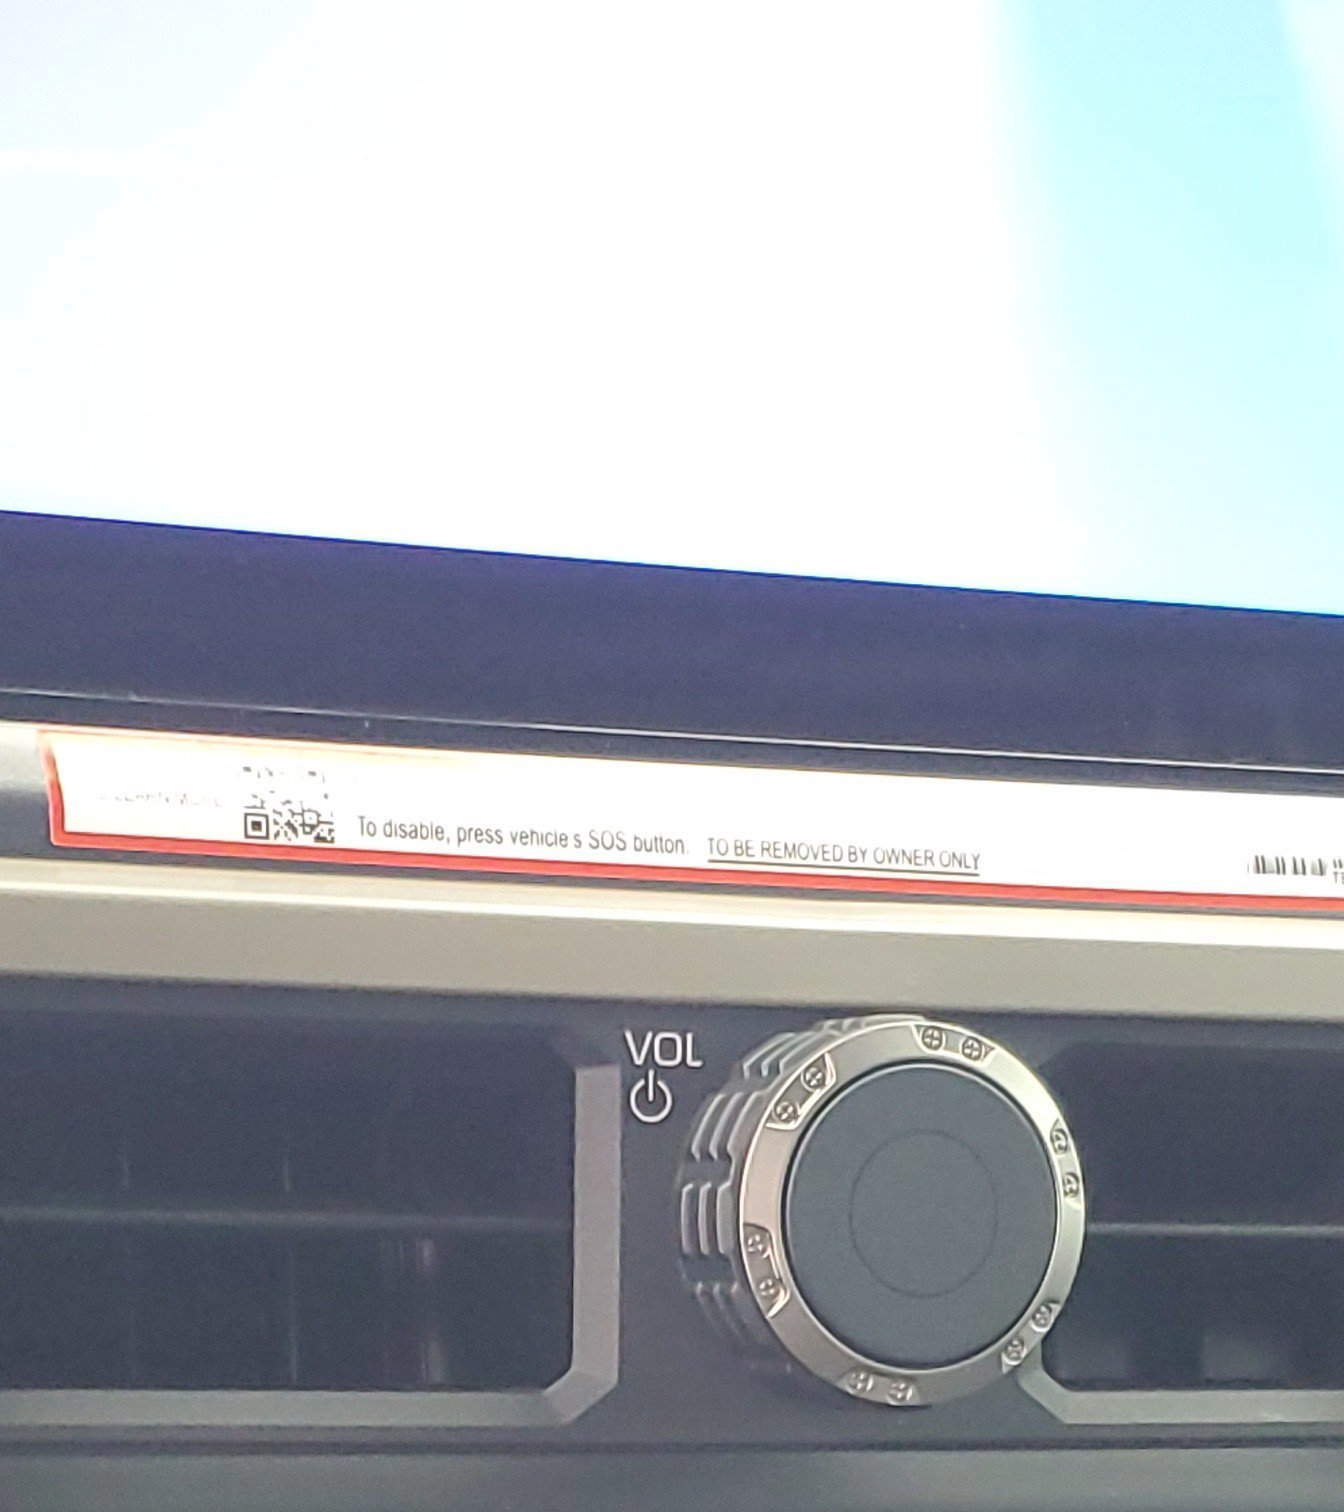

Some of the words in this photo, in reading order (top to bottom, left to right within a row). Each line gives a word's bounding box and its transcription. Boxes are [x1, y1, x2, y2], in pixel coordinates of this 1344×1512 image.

[357, 815, 377, 838] To
[383, 818, 451, 845] disable,
[457, 826, 504, 847] press
[588, 829, 627, 852] SOS
[708, 837, 729, 857] TO
[734, 839, 756, 858] BE
[761, 840, 843, 862] REMOVED
[848, 845, 868, 863] BY
[874, 846, 936, 867] OWNER
[939, 850, 980, 870] ONLY
[624, 1030, 703, 1069] VOL
